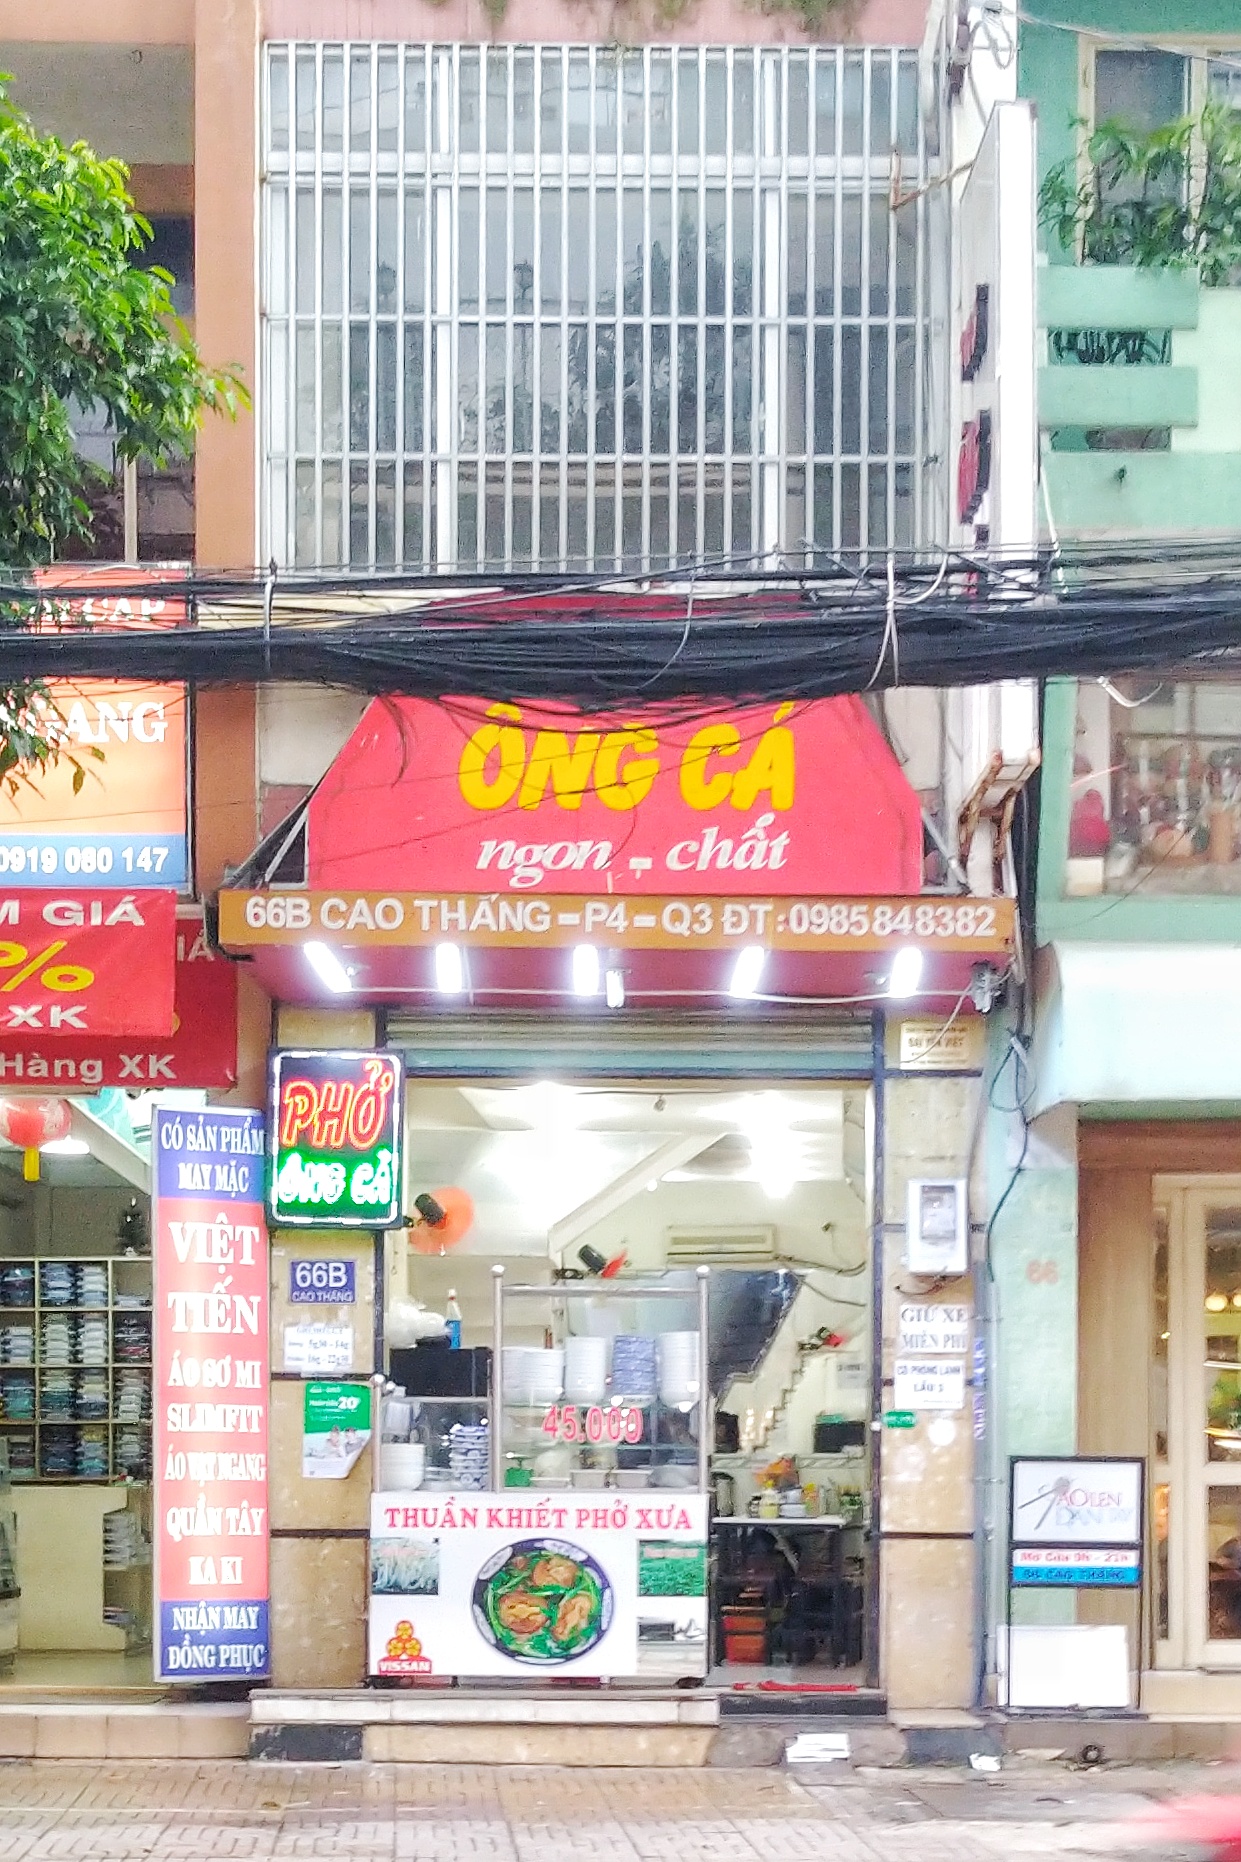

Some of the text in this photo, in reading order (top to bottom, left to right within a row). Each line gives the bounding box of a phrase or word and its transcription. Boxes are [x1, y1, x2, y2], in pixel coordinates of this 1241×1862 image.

[458, 701, 660, 812] ÔNG
[121, 847, 169, 873] 147
[475, 839, 614, 889] ngon
[666, 812, 792, 872] chất
[42, 895, 145, 927] GIÁ
[245, 896, 312, 929] 66B
[320, 897, 405, 931] CAO
[413, 892, 551, 933] THẮNG
[661, 902, 714, 937] Q3
[7, 1004, 88, 1029] XK
[0, 1051, 177, 1084] Hàng XK
[281, 1059, 394, 1149] PHỞ
[161, 1115, 184, 1150] CÓ
[186, 1115, 218, 1152] SẢN
[178, 1159, 249, 1198] MAY MẶC
[168, 1211, 260, 1274] VIỆT
[295, 1262, 348, 1288] 66B
[167, 1275, 262, 1335] TIẾN
[292, 1291, 316, 1302] CAO
[942, 1306, 967, 1323] XE
[167, 1350, 201, 1388] ÁO
[235, 1360, 262, 1389] MI
[337, 1395, 362, 1411] 20
[542, 1404, 643, 1444] 45.000
[164, 1443, 187, 1481] ÁO
[225, 1499, 265, 1536] TÂY
[384, 1496, 693, 1530] THUẦN KHIẾT PHỞ XƯA
[172, 1600, 259, 1635] NHẬN MAY
[167, 1633, 266, 1673] ĐỒNG PHỤC
[379, 1660, 431, 1673] VISSAN
